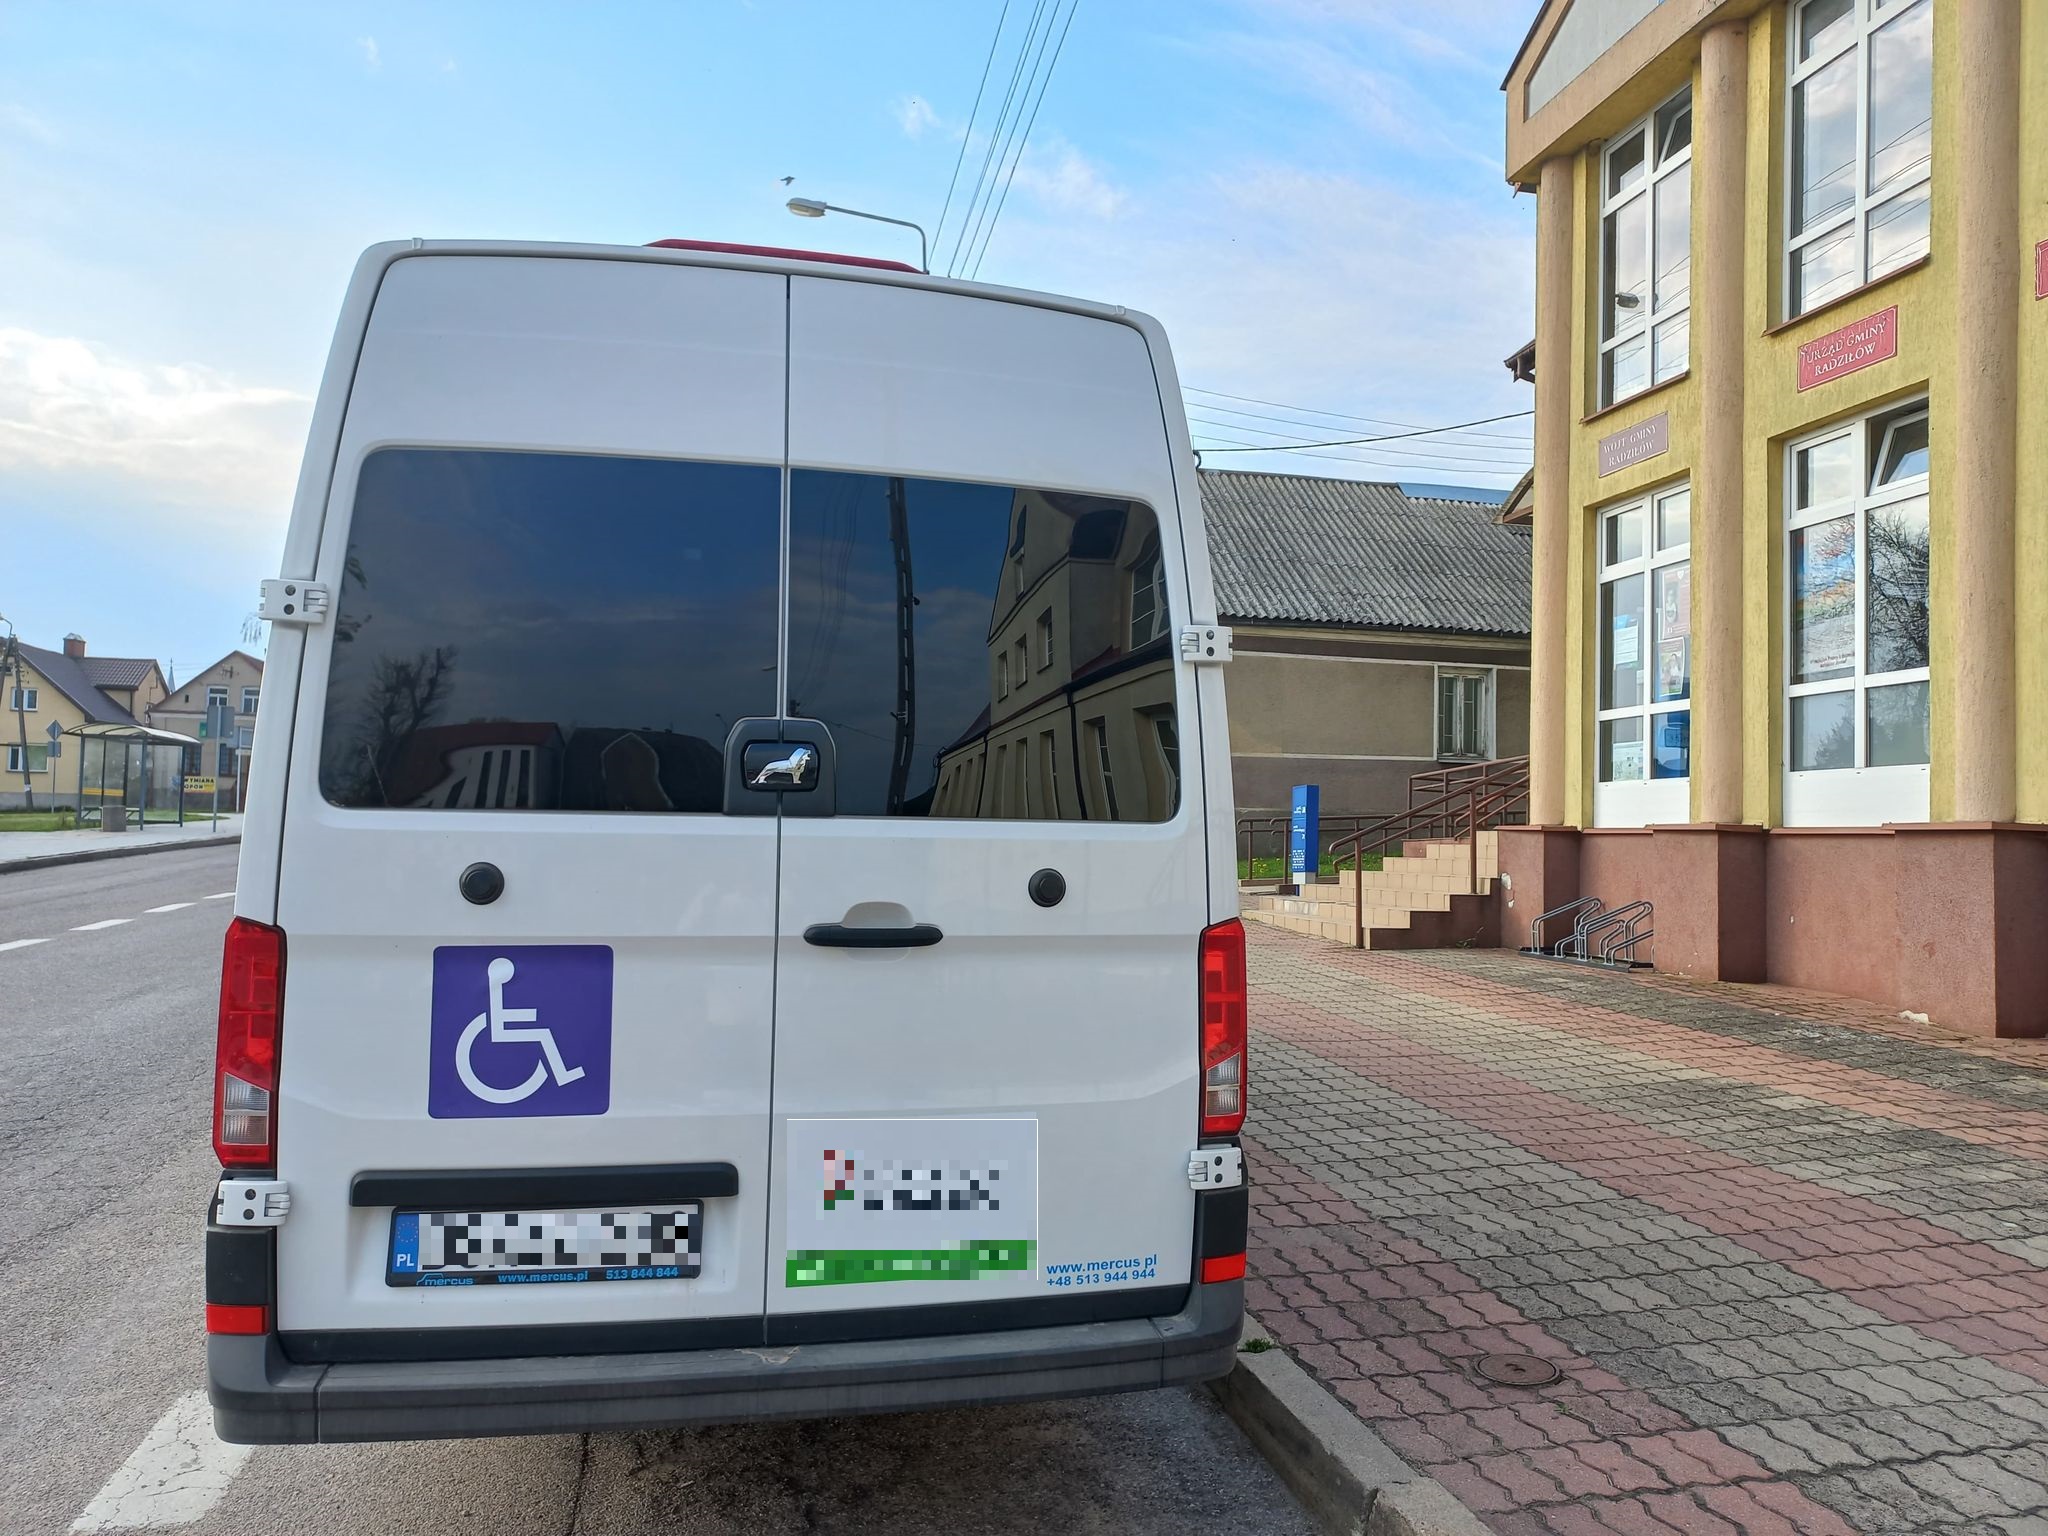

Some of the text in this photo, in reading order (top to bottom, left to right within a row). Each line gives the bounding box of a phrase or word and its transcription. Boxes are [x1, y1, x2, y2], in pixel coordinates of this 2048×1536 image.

[1807, 321, 1886, 363] URZĄD GMINY
[1814, 341, 1876, 376] RADZIŁÓW
[1630, 425, 1656, 443] GMINY
[396, 1253, 415, 1267] PL
[497, 1270, 589, 1283] www.mercus.pl
[605, 1266, 679, 1280] 513 844 844
[1047, 1268, 1156, 1287] +48 513 944 944
[424, 1277, 474, 1286] mercus
